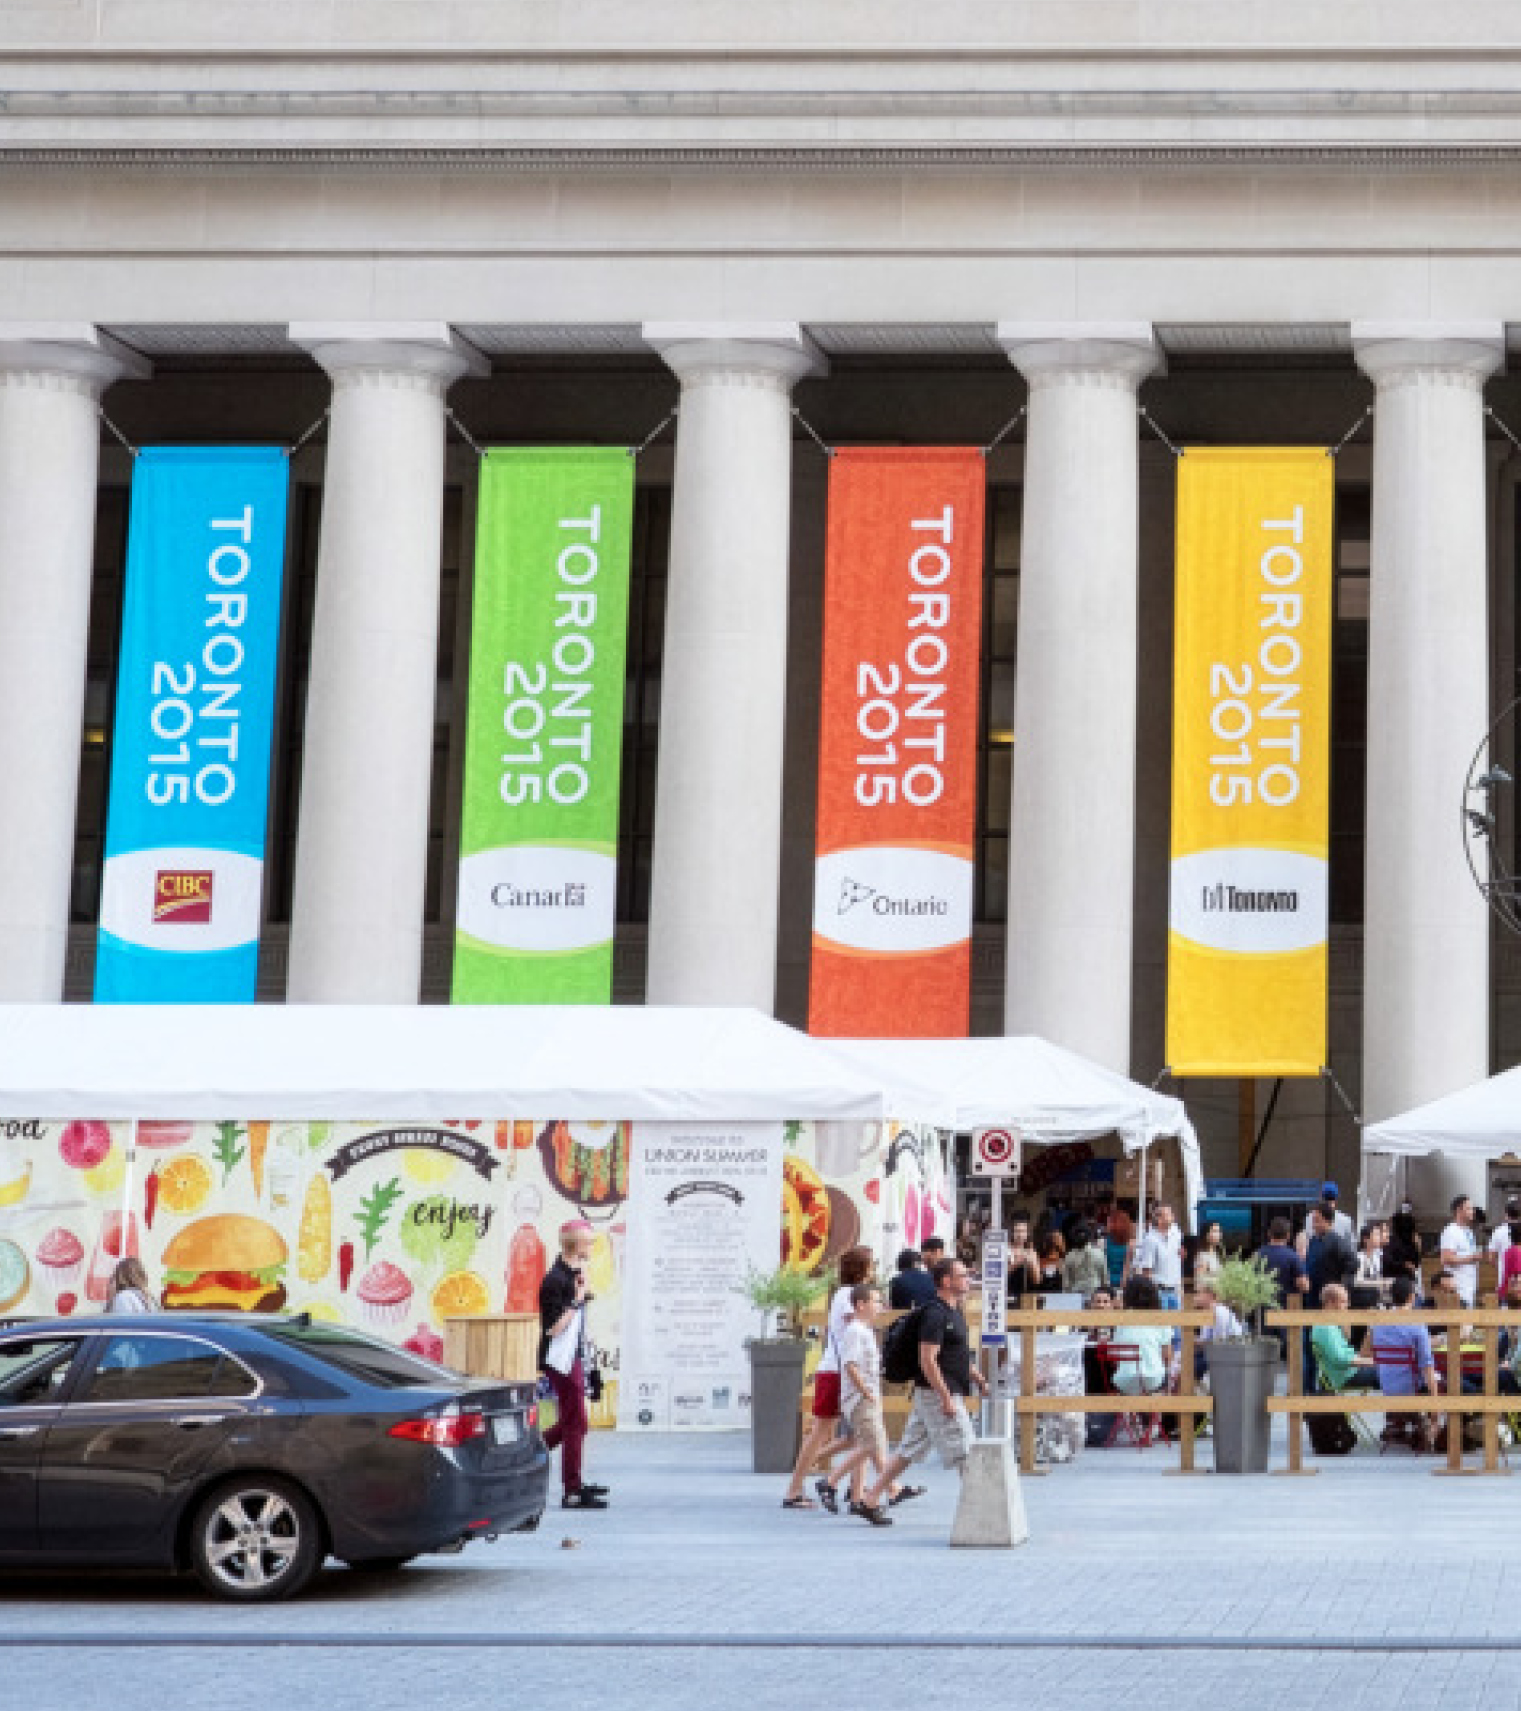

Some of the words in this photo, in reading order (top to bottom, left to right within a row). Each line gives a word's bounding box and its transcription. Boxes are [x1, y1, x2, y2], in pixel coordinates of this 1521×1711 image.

[196, 507, 251, 804] TORONTO
[545, 504, 601, 807] TORONTO
[901, 506, 954, 807] TORONTO
[1257, 504, 1304, 807] TORONTO
[147, 663, 194, 804] 2015
[501, 661, 547, 807] 2015
[853, 664, 901, 807] 2015
[1209, 664, 1253, 807] 2015
[157, 874, 211, 897] CIBC
[490, 882, 586, 908] Canada
[872, 894, 949, 917] Ontario
[413, 1201, 495, 1240] enjoy
